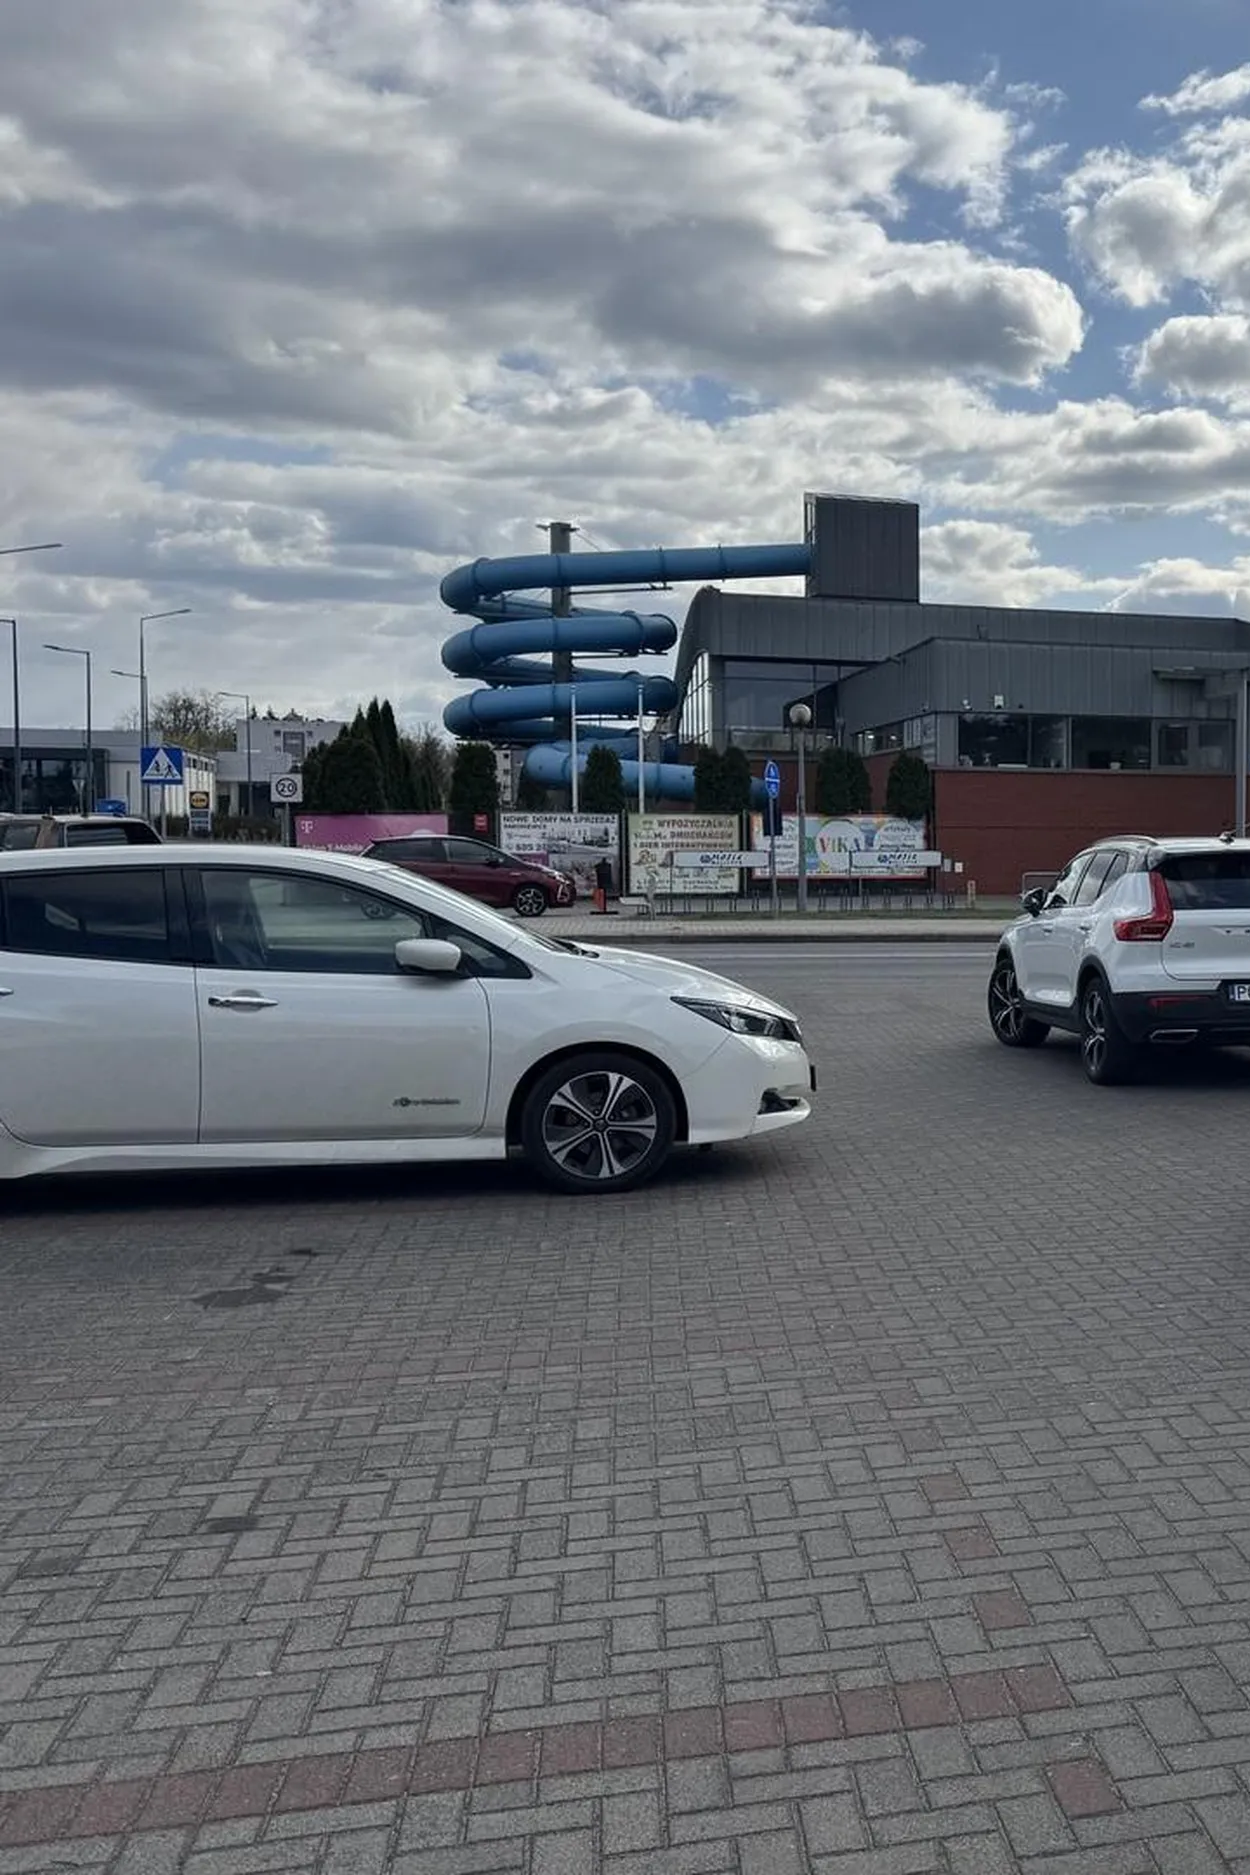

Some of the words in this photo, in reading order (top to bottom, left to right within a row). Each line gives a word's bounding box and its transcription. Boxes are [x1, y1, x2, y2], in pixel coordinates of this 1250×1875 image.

[280, 782, 295, 793] 20
[503, 815, 528, 823] NOWE
[532, 815, 557, 824] DOMY
